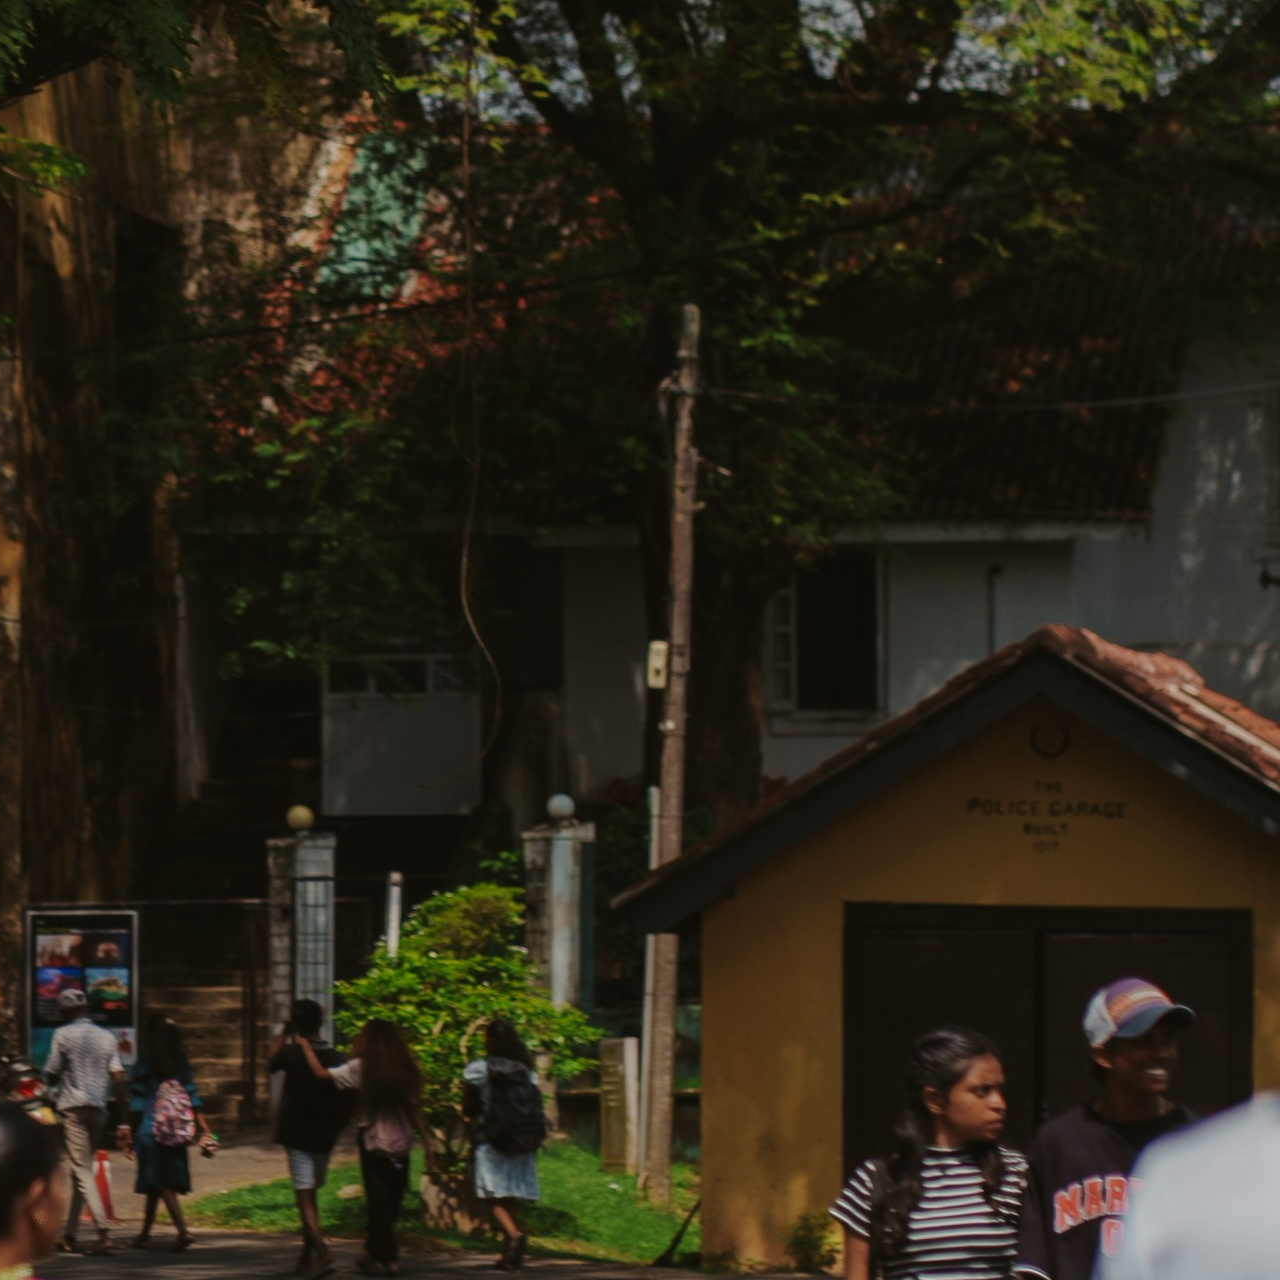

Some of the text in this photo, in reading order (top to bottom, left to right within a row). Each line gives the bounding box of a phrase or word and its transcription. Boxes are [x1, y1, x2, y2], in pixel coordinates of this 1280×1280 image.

[1034, 780, 1063, 794] THE
[967, 798, 1128, 819] POLICE GARAGE
